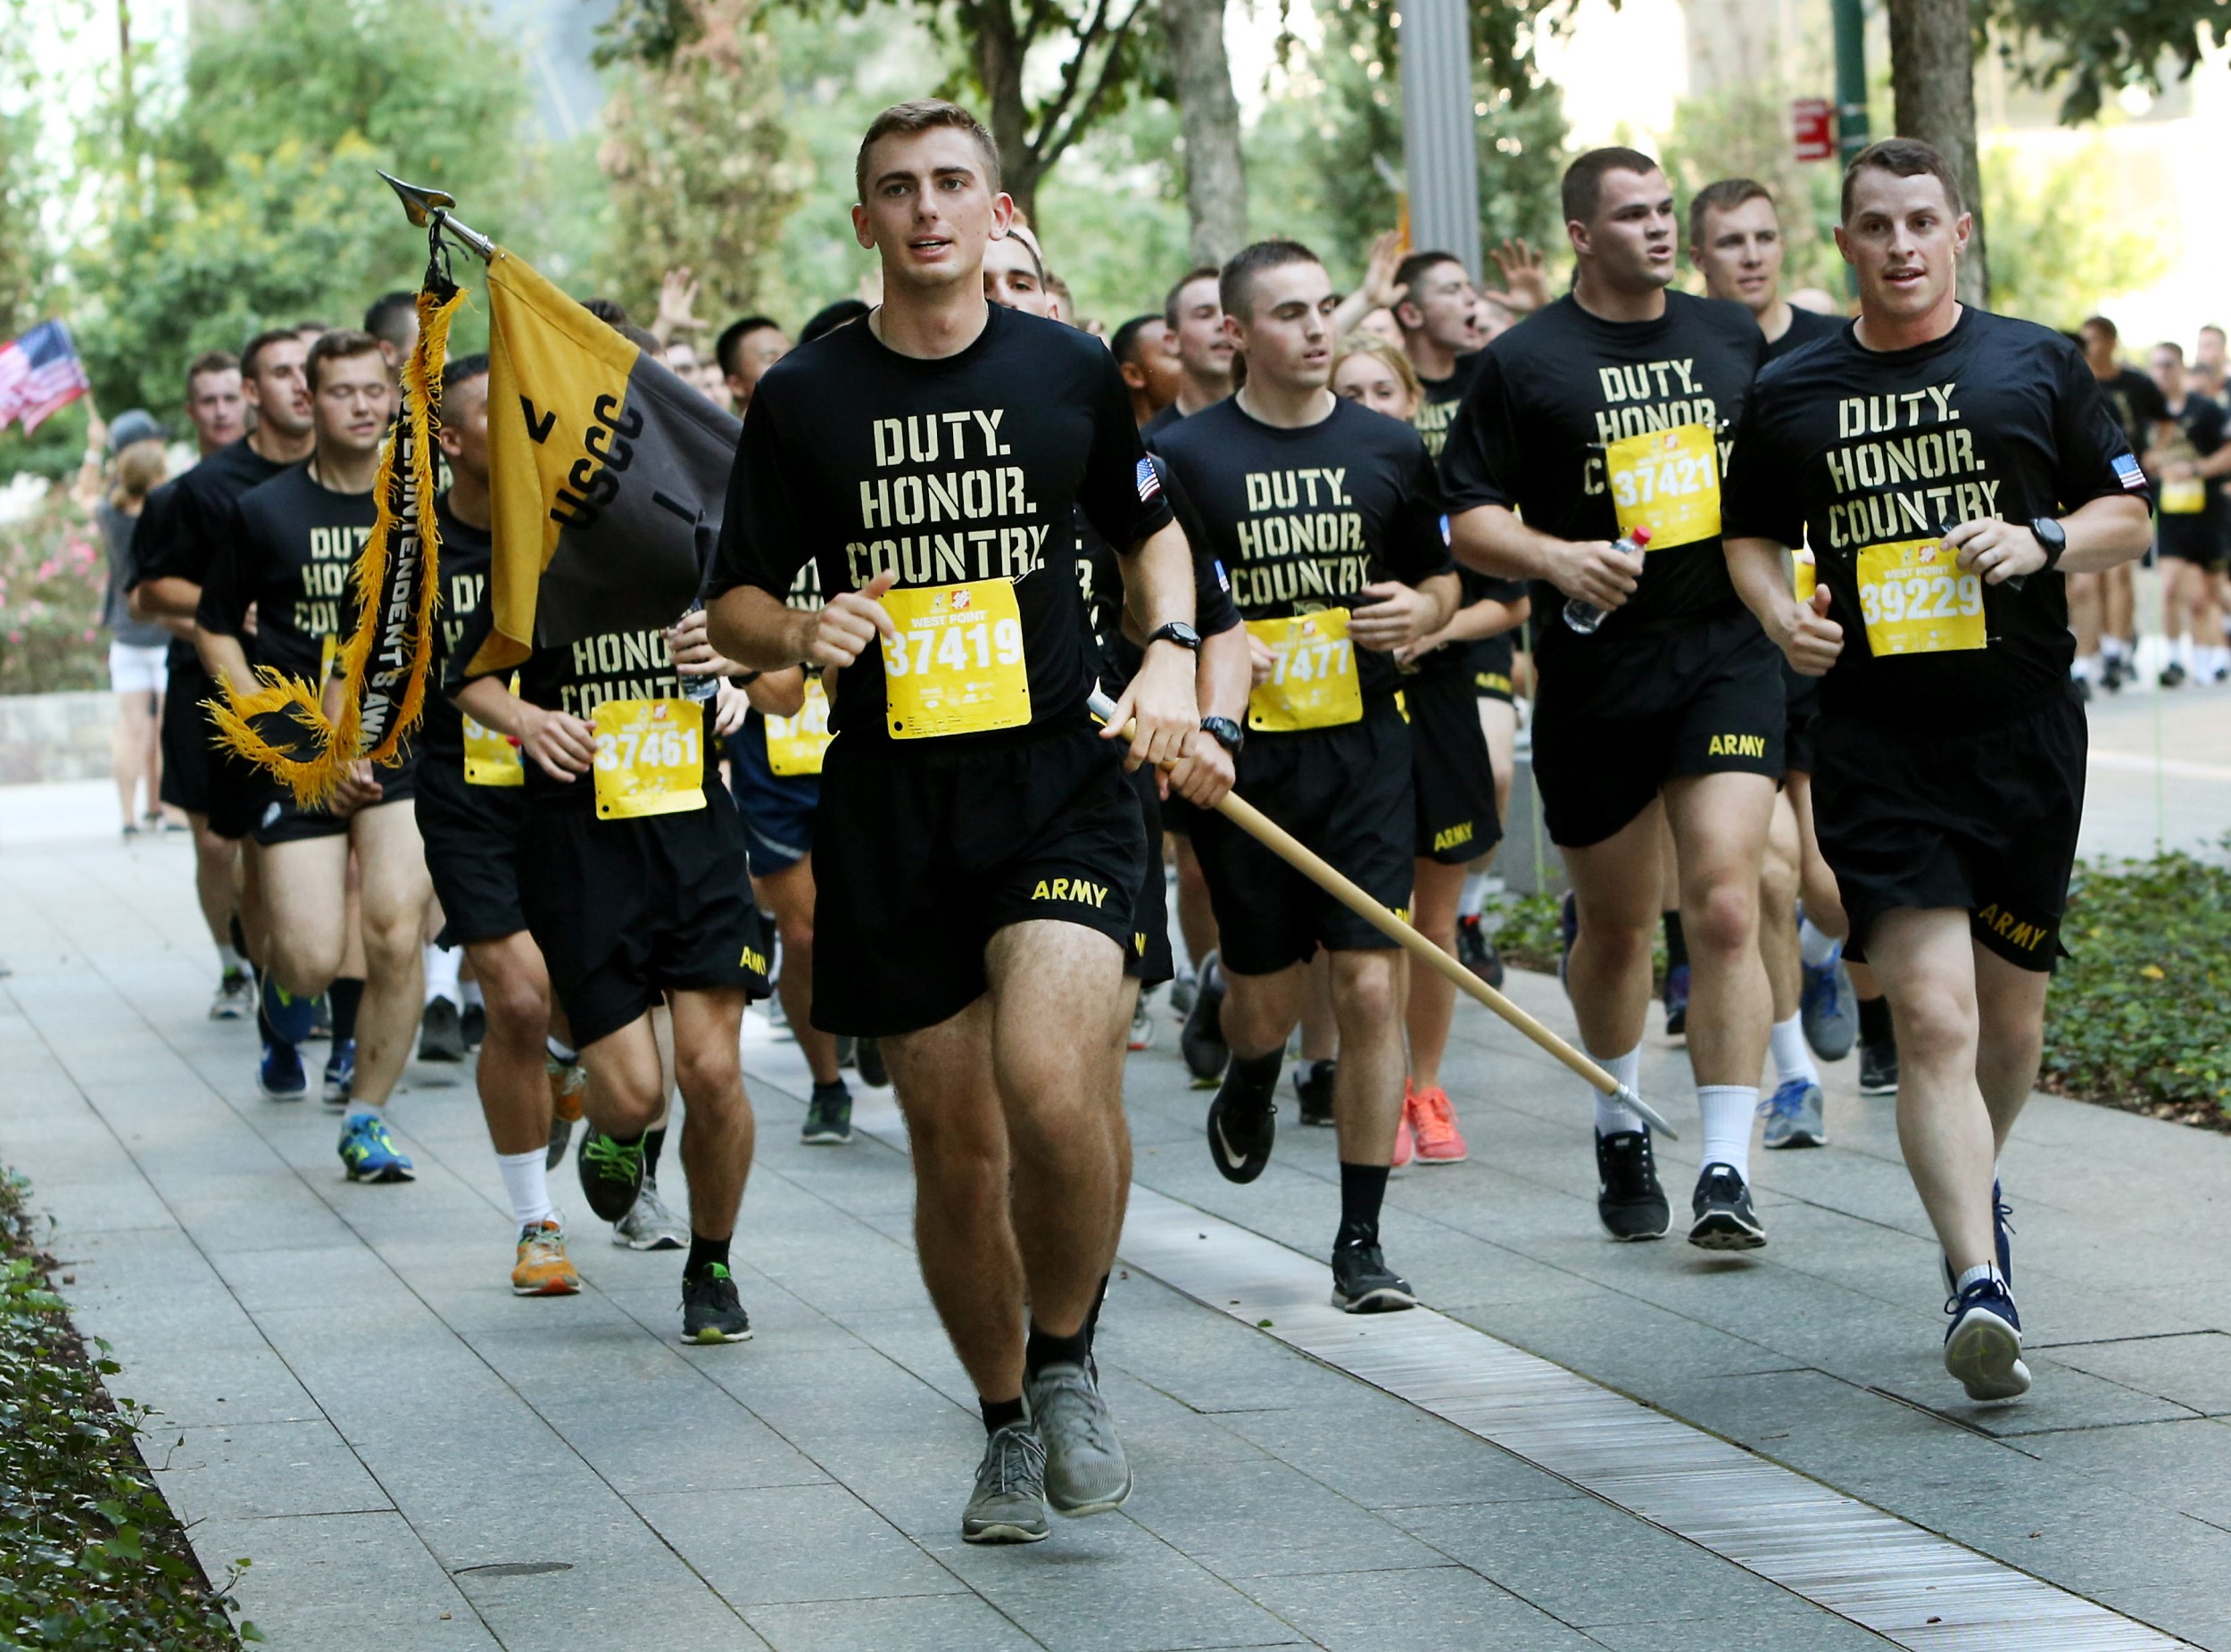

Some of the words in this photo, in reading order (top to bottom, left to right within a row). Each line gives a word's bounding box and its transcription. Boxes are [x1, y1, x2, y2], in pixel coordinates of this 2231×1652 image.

[1598, 358, 1704, 403] DUTY.
[1839, 383, 1960, 438] DUTY.
[550, 393, 644, 531] USCC
[873, 409, 1011, 467] DUTY.
[1826, 428, 1986, 494] HONOR.
[859, 467, 1037, 529] HONOR.
[1245, 468, 1352, 511] DUTY.
[1613, 453, 1714, 507] 37421
[1237, 512, 1365, 560] HONOR.
[1829, 479, 2003, 548] COUNTRY.
[310, 527, 372, 559] DUT
[846, 524, 1050, 589] COUNTRY.
[911, 615, 946, 628] WEST
[949, 610, 986, 624] POINT
[1860, 574, 1982, 625] 39229
[572, 629, 671, 676] HONO
[883, 618, 1022, 677] 37419
[1273, 638, 1351, 686] 7477
[595, 728, 698, 772] 37461
[1708, 734, 1765, 758] ARMY
[1434, 821, 1473, 851] ARMY
[1031, 877, 1108, 909] ARMY
[1978, 903, 2047, 951] ARMY
